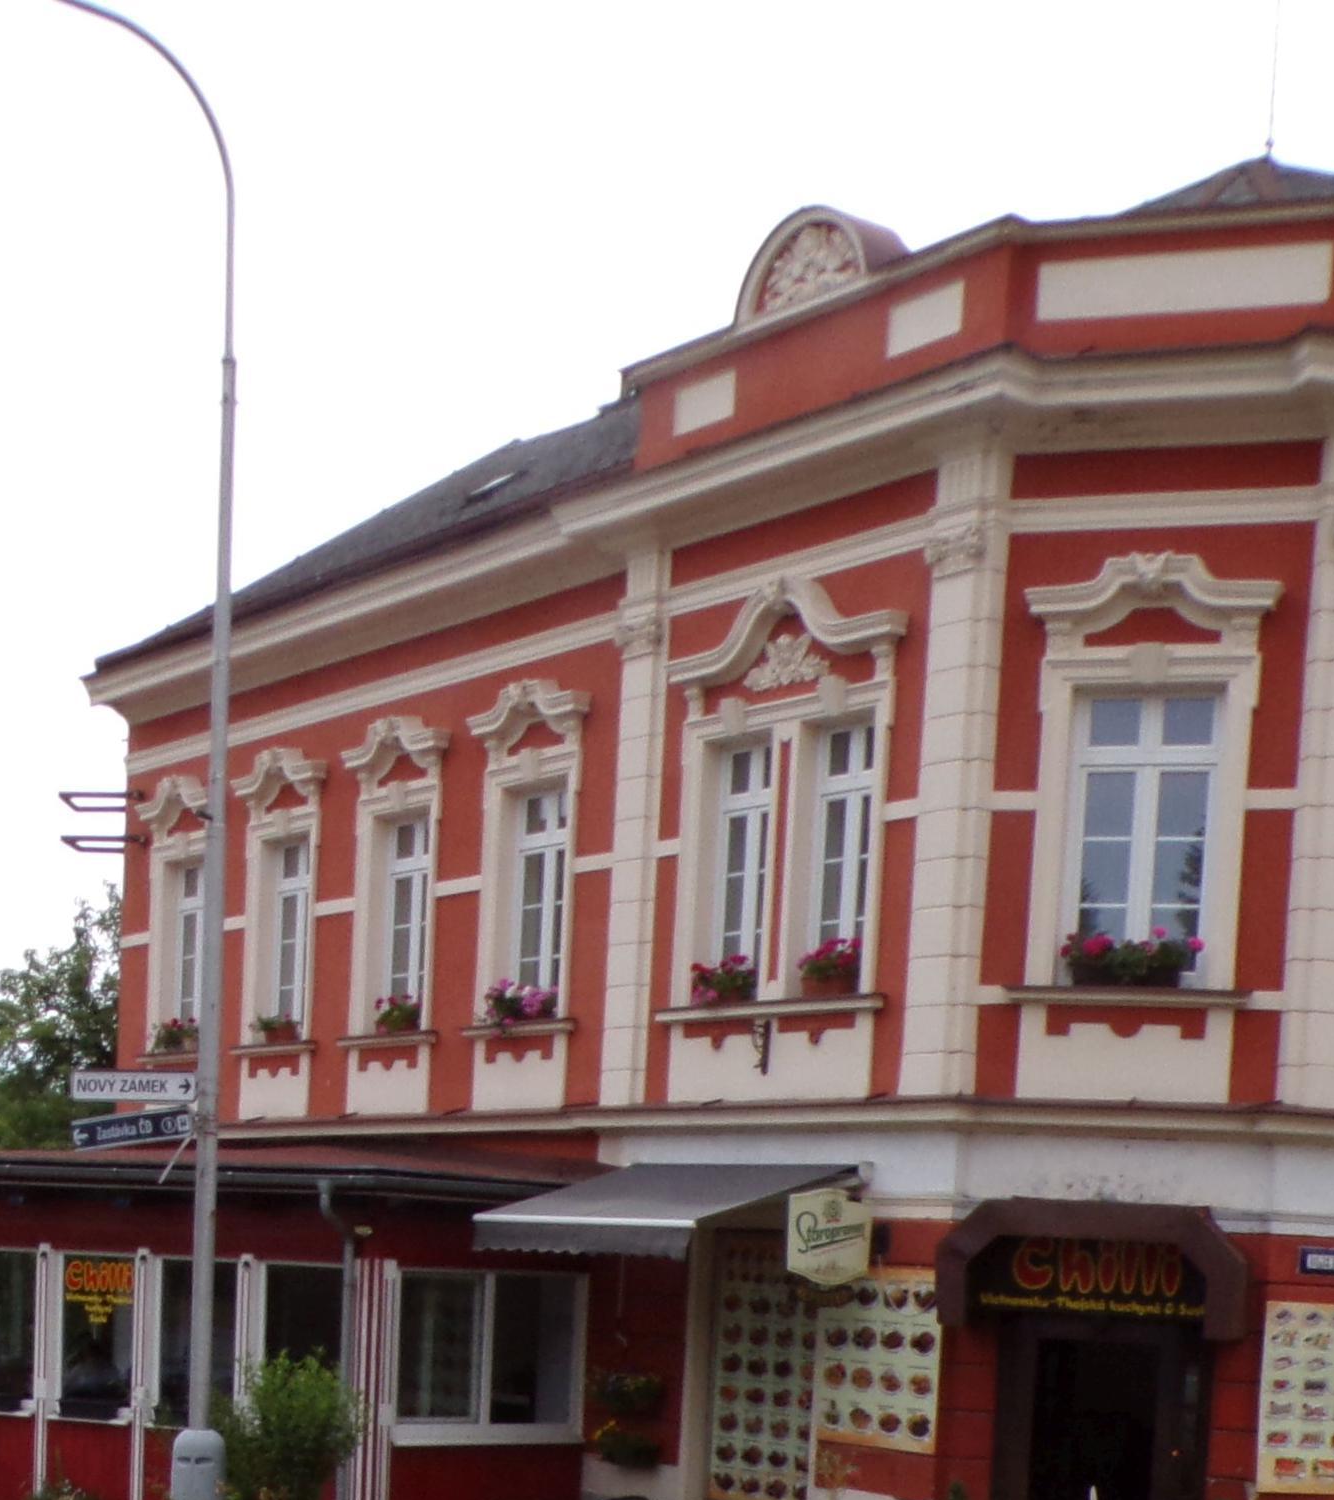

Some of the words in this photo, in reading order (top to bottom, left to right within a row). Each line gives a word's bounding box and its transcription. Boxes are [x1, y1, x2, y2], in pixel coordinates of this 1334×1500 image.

[76, 1074, 115, 1093] NOVÝ
[119, 1074, 168, 1093] ZÁMEK
[65, 1259, 134, 1292] Chilli
[1013, 1237, 1181, 1296] Chilli
